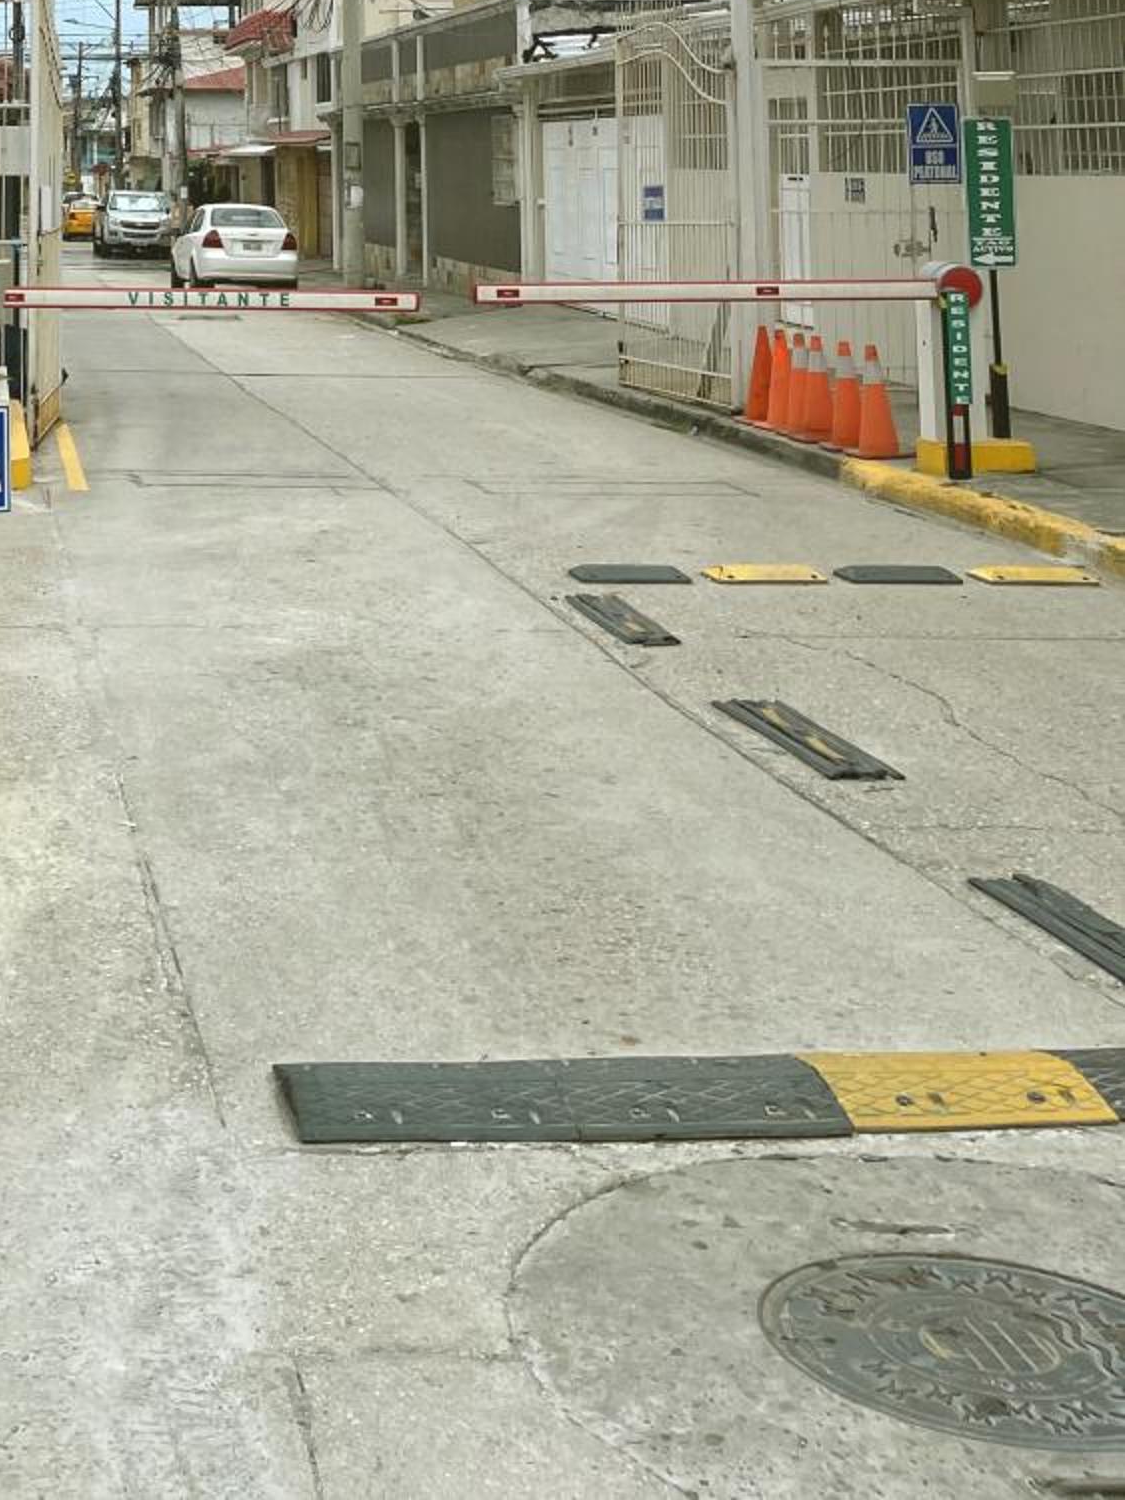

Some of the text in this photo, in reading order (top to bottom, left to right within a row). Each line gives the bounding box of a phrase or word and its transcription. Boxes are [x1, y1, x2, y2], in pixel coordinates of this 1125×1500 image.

[976, 121, 1003, 236] RESIDENTE
[128, 292, 291, 307] VISITANTE
[950, 293, 971, 404] RESIDENTE
